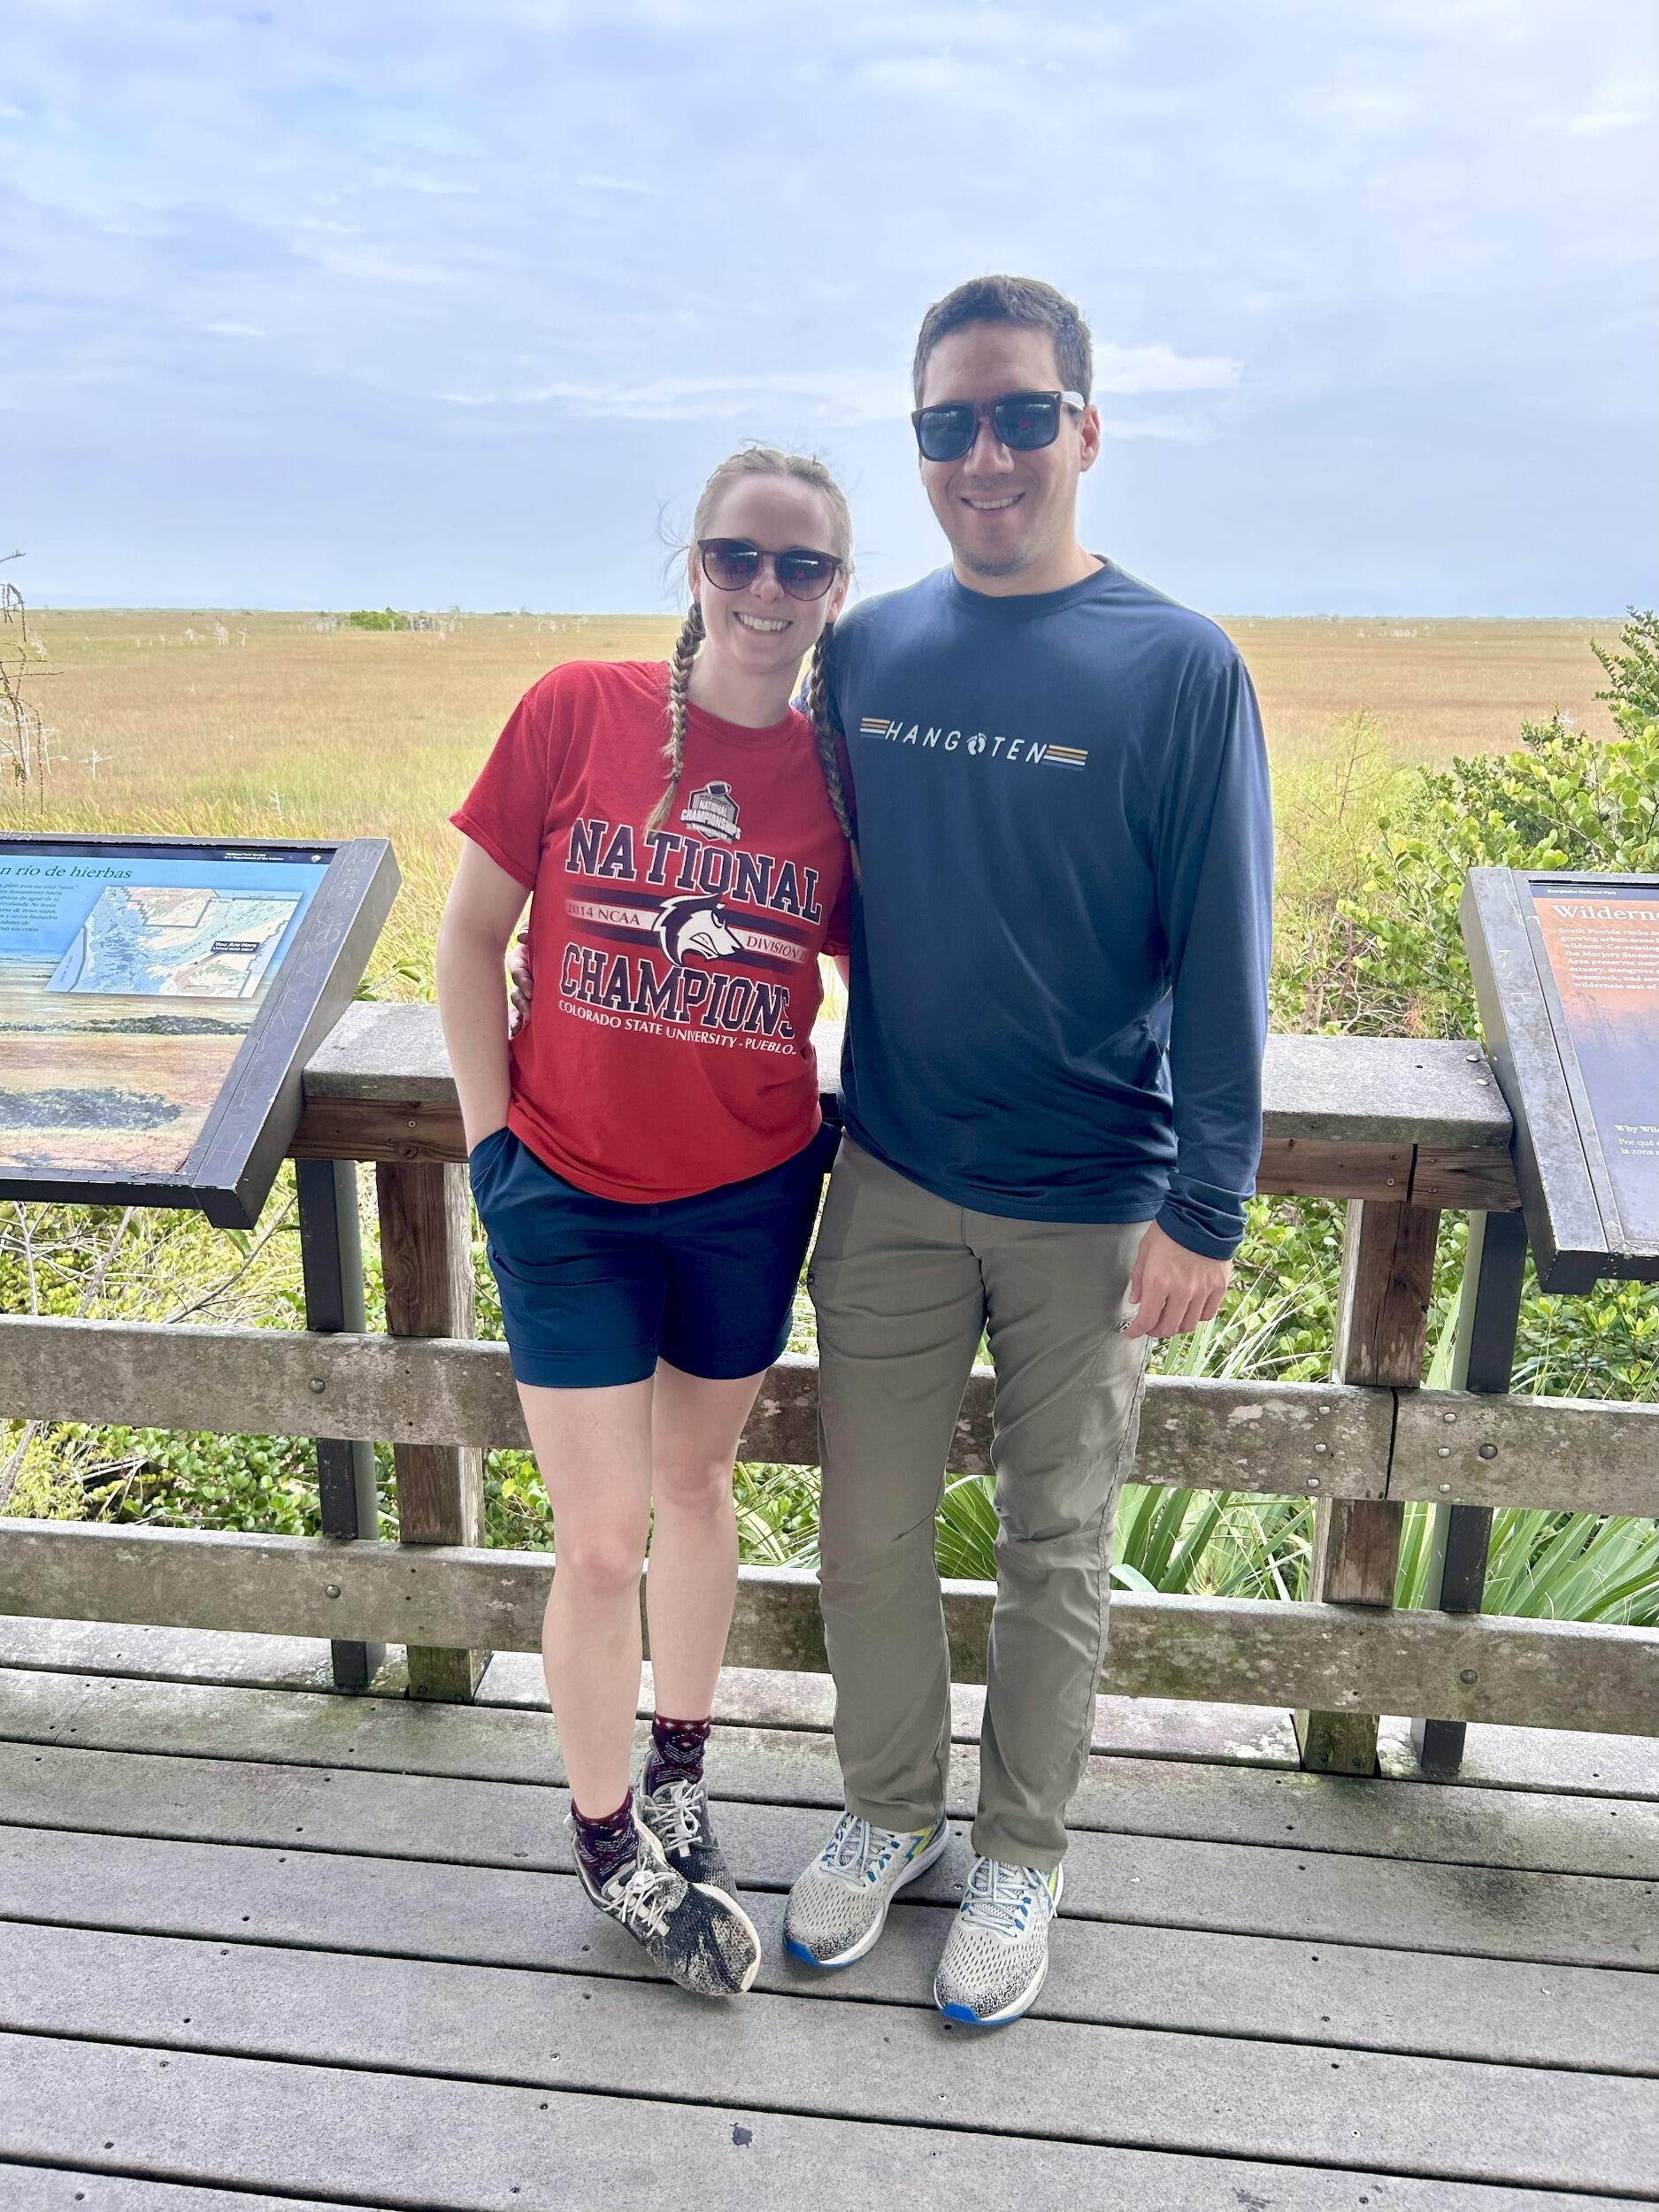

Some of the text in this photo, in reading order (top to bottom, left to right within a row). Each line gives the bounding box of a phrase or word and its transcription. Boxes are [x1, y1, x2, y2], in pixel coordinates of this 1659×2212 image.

[885, 720, 1048, 764] HANG TEN
[698, 799, 727, 818] NATIONAL
[680, 809, 741, 840] CHAMPIONSHIPS
[15, 865, 41, 876] río
[44, 865, 66, 877] de
[70, 866, 133, 879] hierbas
[565, 818, 822, 925] NATIONAL
[567, 903, 640, 926] 2014 NCAA
[747, 936, 800, 958] DIVISION
[559, 942, 795, 1039] CHAMPIONS
[558, 1000, 621, 1028] COLORADO
[625, 1018, 663, 1035] STATE
[665, 1026, 737, 1048] UNIVERSITY
[1615, 1125, 1637, 1133] Why
